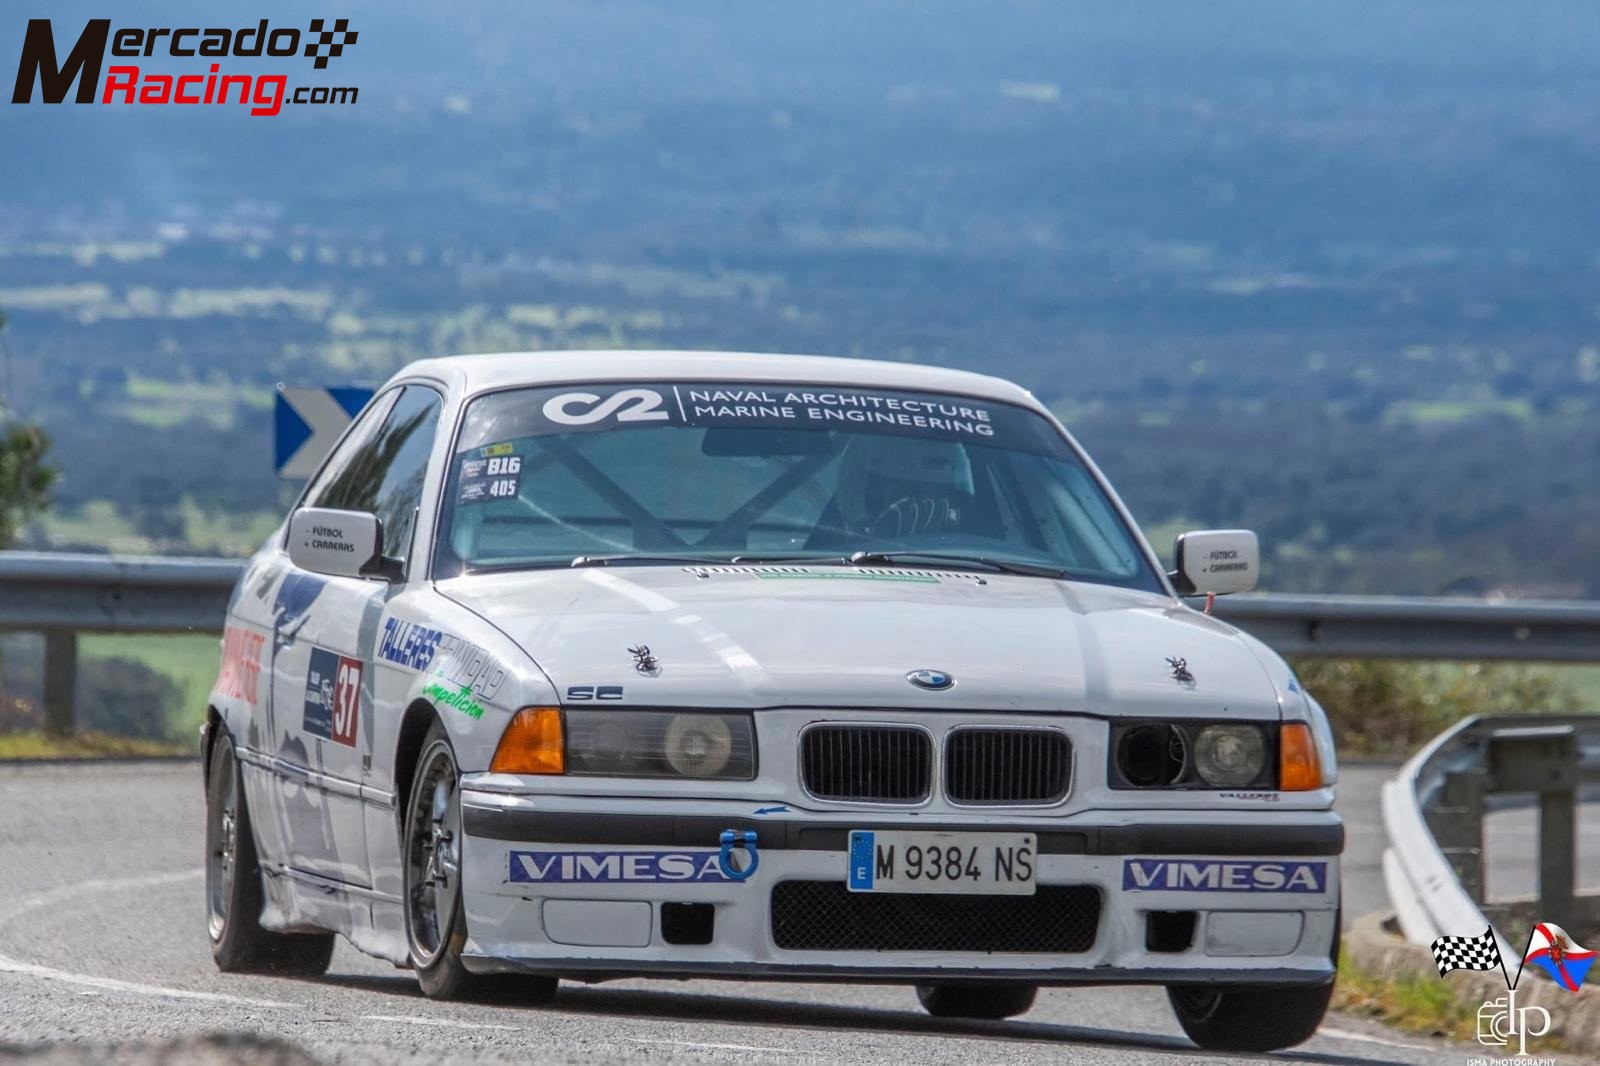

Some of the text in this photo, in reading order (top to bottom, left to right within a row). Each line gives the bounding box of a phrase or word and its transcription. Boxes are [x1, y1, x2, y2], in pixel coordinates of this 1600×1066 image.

[690, 391, 991, 422] NAVAL ARCHITECTURE
[695, 406, 994, 436] MARINE ENGINEERING
[490, 480, 516, 497] 405
[311, 540, 354, 553] CARRERAS
[378, 617, 443, 673] TALLERES
[334, 663, 360, 738] 37
[857, 867, 866, 879] E
[876, 845, 1032, 881] M 9384 NS
[1130, 862, 1319, 889] VIMESA
